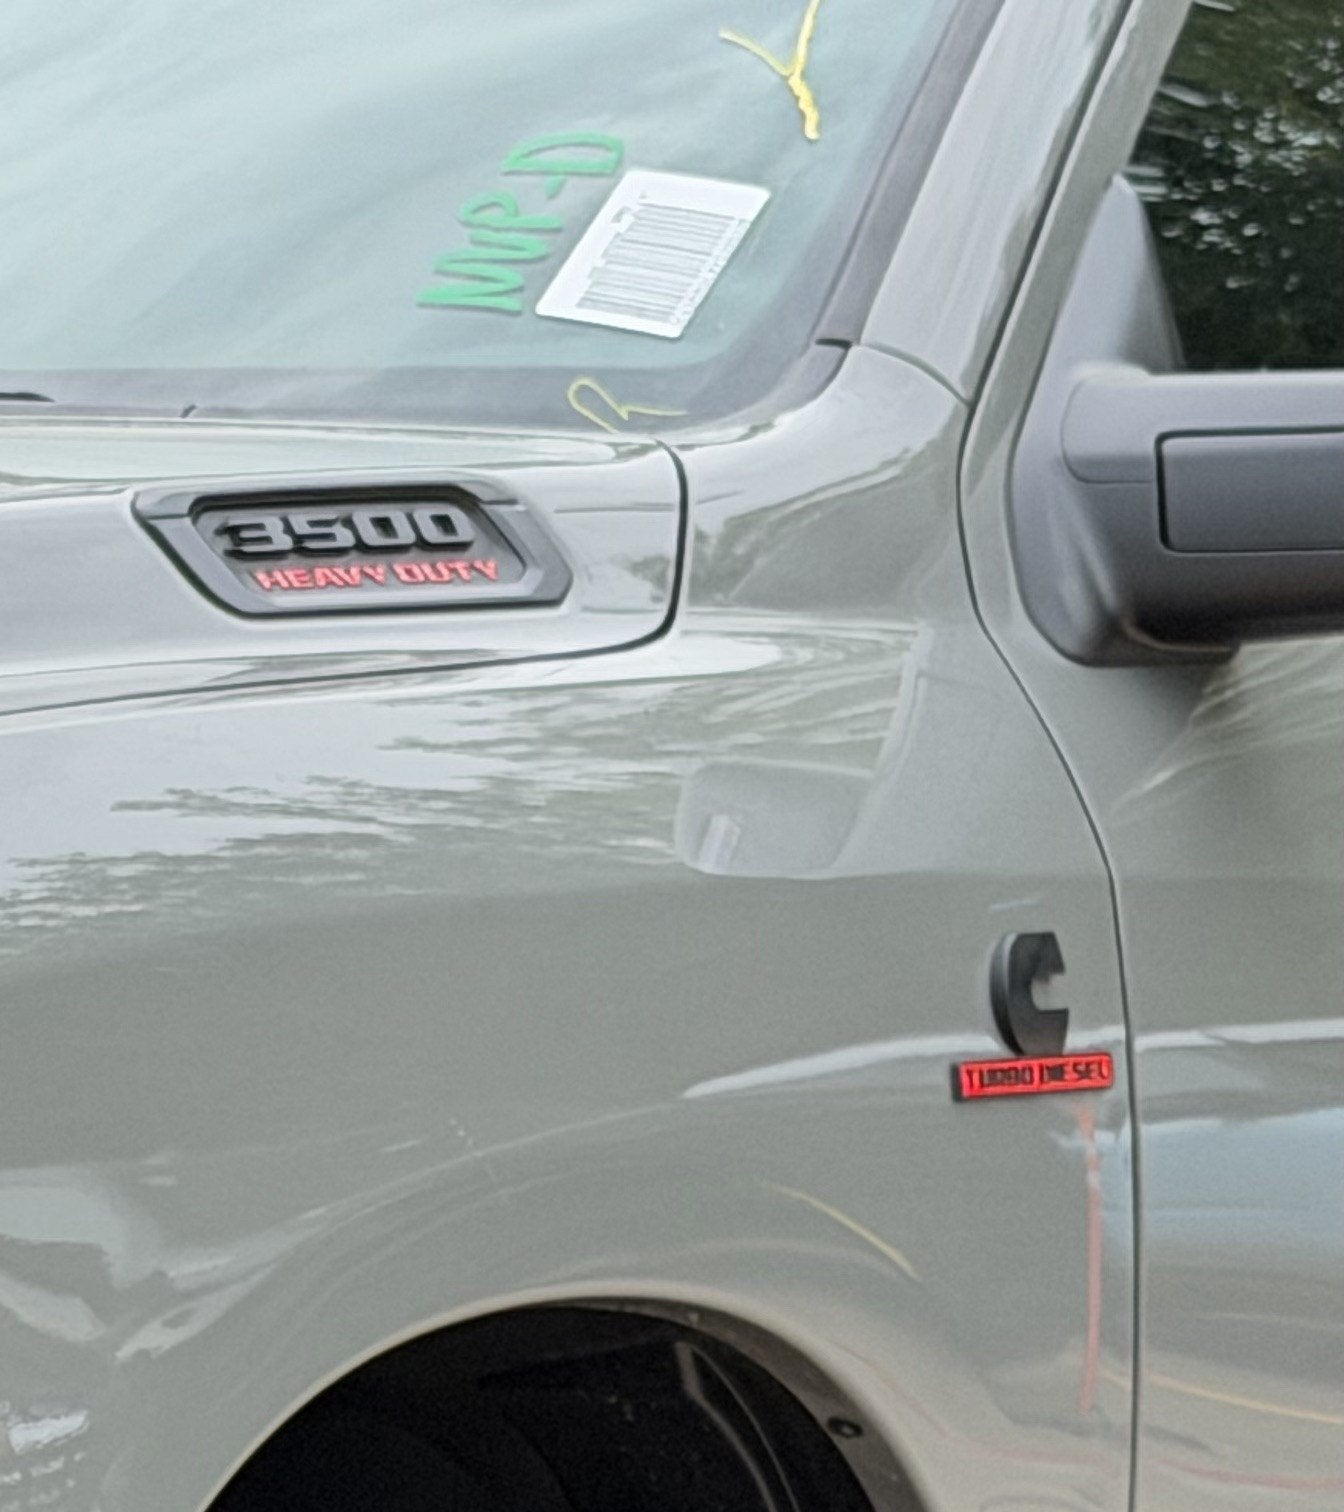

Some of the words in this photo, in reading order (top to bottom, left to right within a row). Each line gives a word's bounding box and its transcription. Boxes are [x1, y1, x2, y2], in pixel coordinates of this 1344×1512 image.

[220, 508, 475, 559] 3500
[255, 563, 387, 593] HEAVY
[392, 558, 500, 587] DUTY
